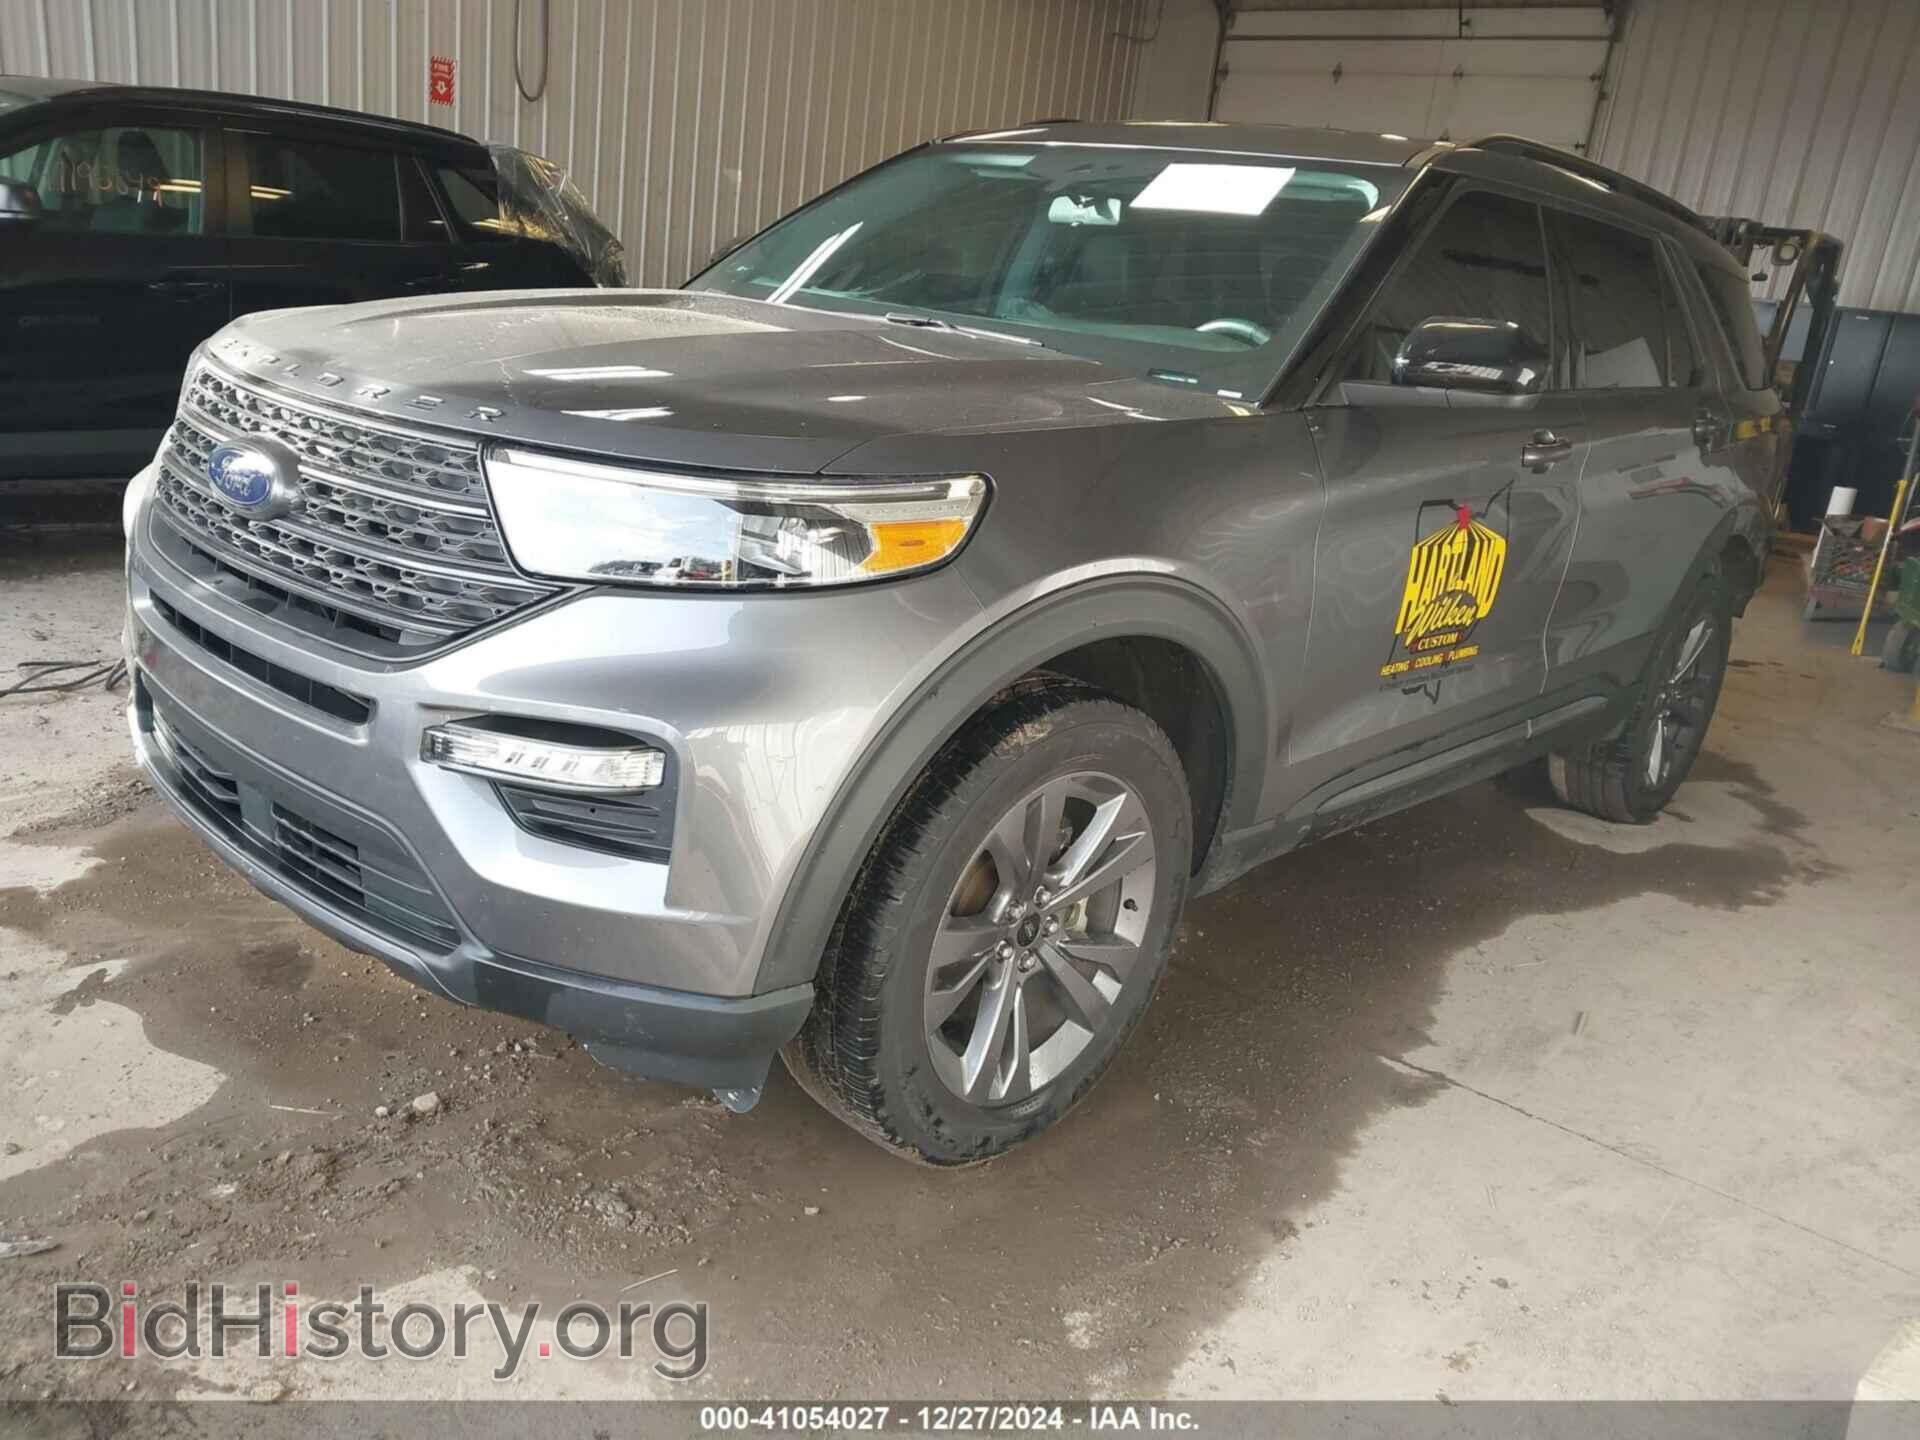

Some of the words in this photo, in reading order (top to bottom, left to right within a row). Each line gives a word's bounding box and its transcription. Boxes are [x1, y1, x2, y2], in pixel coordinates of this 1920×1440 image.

[1395, 524, 1507, 635] HARTLAND
[1417, 632, 1460, 651] CUSTOM
[1380, 660, 1411, 677] HEATING
[1415, 653, 1445, 669] COOLING
